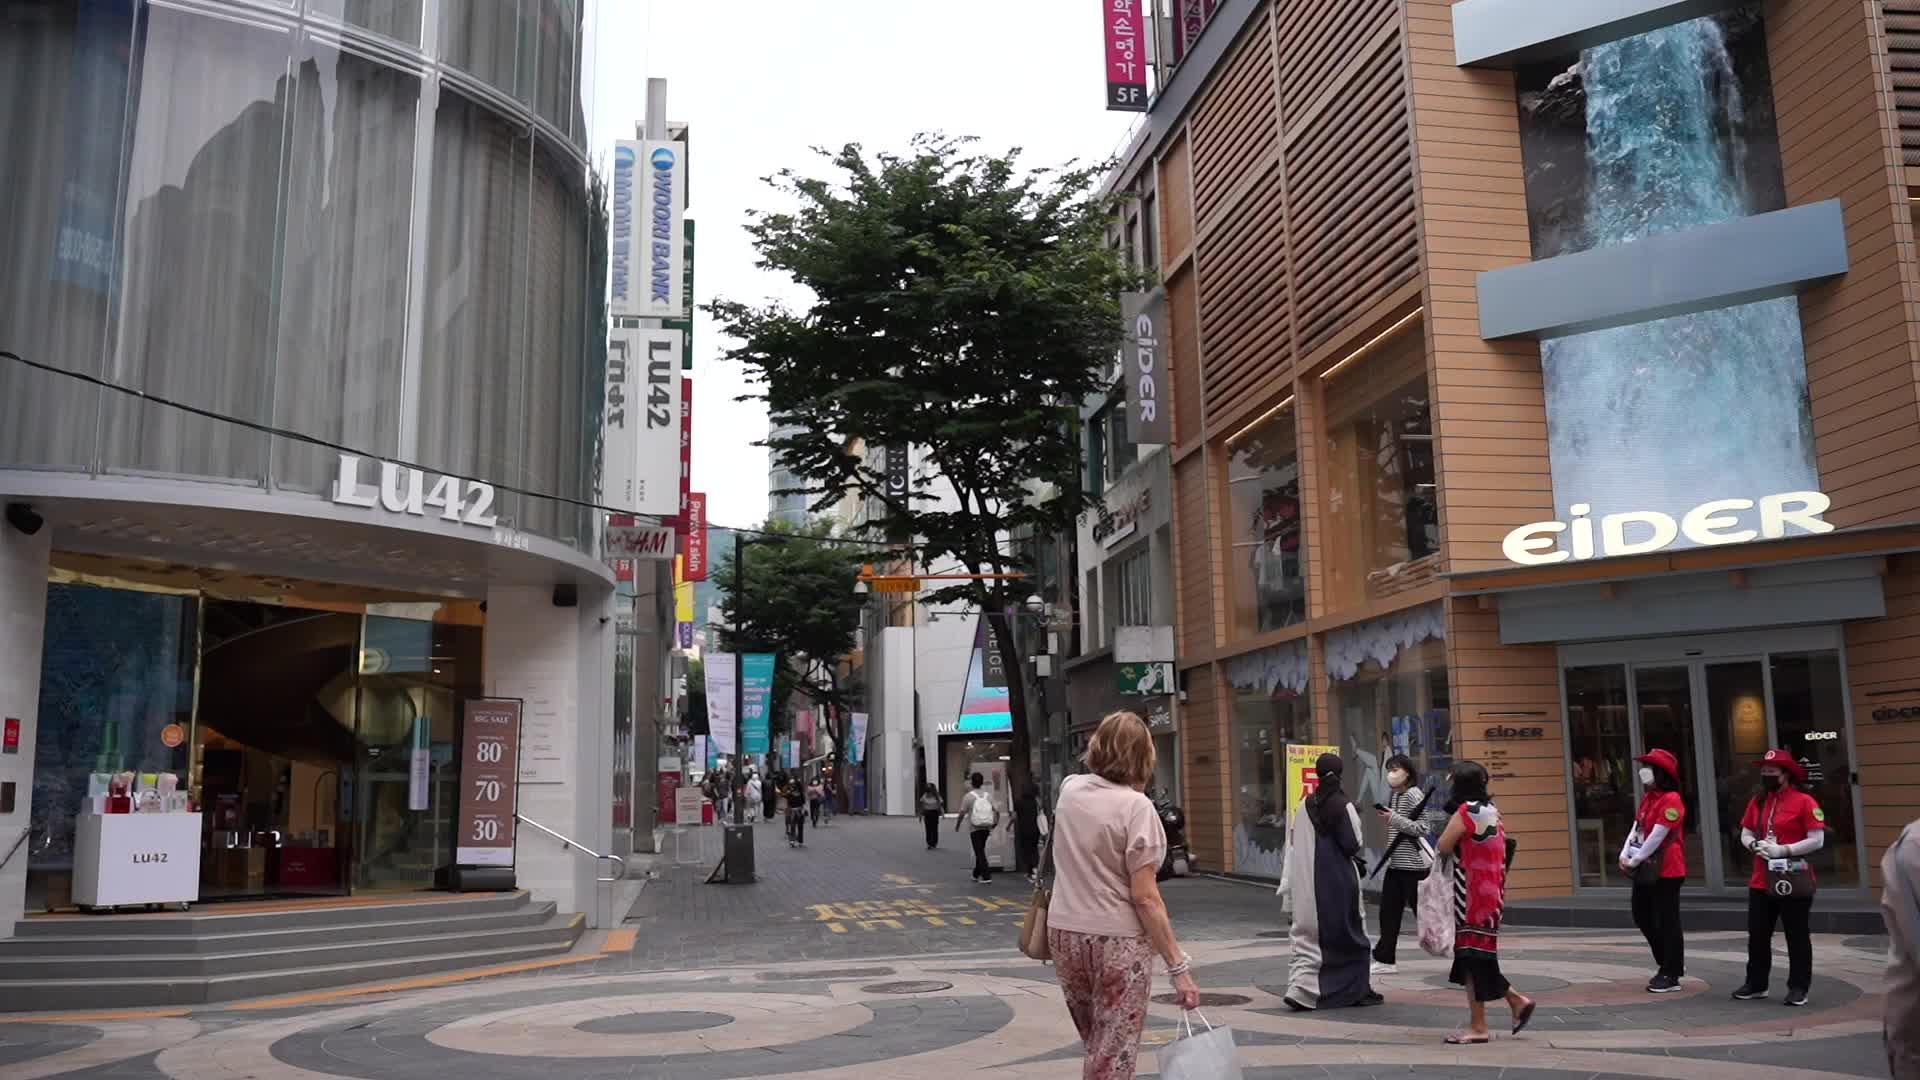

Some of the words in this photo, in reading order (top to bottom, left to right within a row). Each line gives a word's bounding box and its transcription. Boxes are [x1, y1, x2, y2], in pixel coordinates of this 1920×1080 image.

[1112, 0, 1136, 81] 약손명가
[1116, 87, 1139, 103] 5F
[651, 171, 672, 241] WOORI
[651, 241, 671, 304] BANK
[648, 340, 672, 430] LU42
[133, 853, 168, 864] LU42
